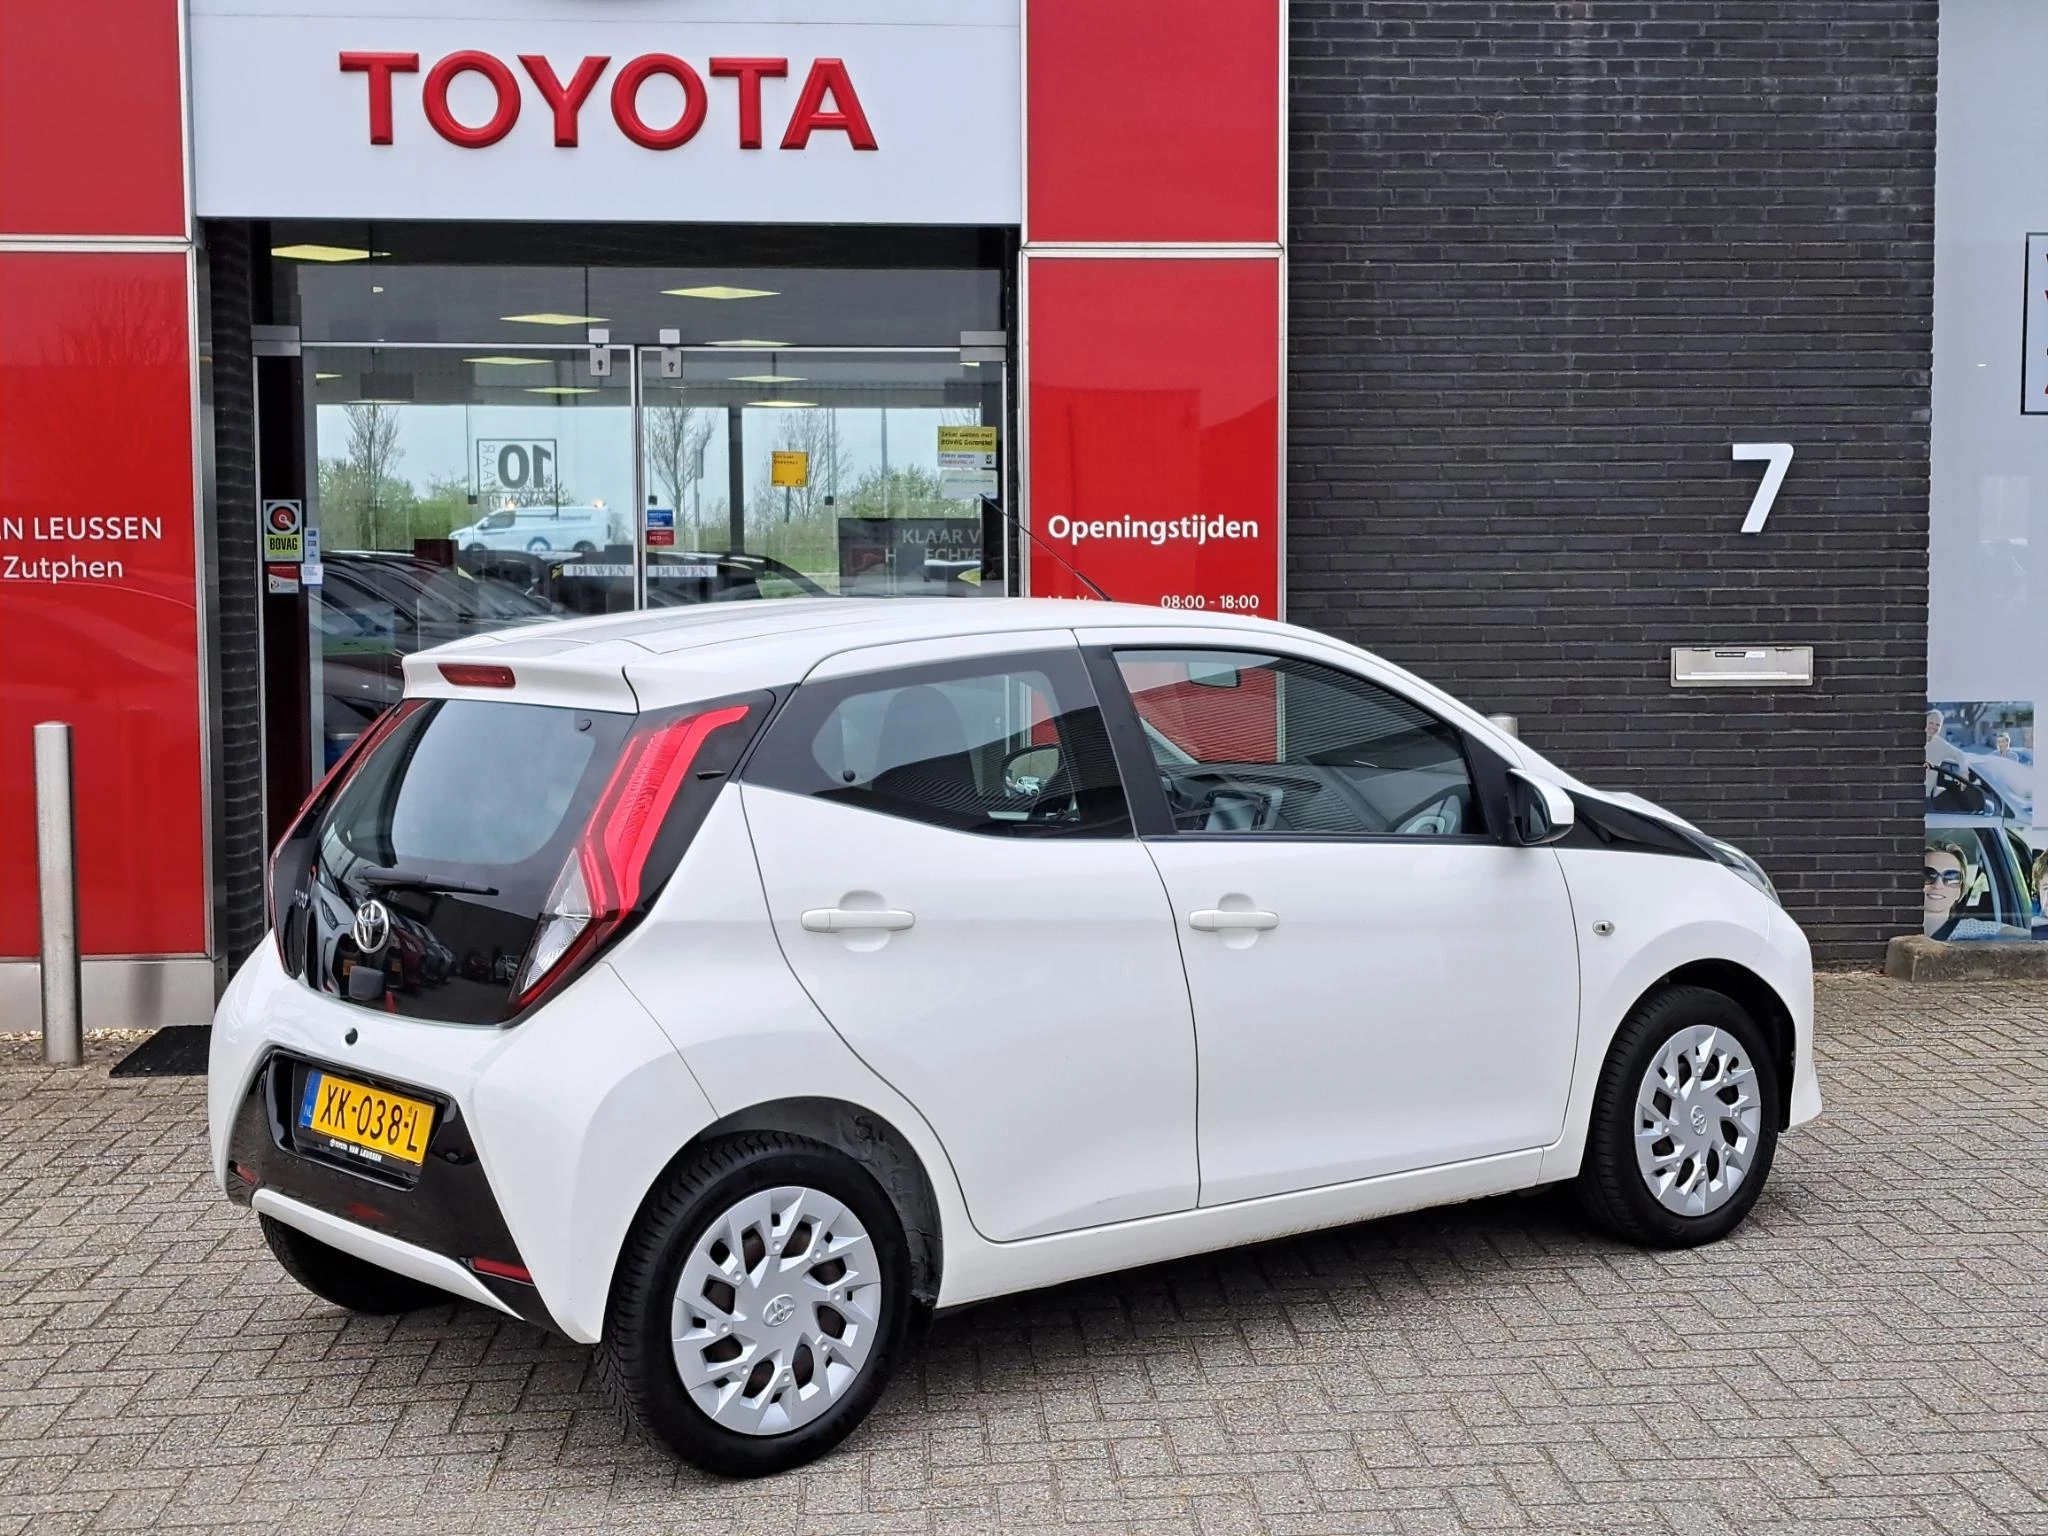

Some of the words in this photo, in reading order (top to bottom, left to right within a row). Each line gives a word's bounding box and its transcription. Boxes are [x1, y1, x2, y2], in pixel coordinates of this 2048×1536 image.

[339, 49, 879, 151] TOYOTA
[1732, 443, 1794, 533] 7
[0, 517, 23, 540] N
[34, 516, 162, 540] LEUSSEN
[902, 528, 963, 544] KLAAR
[1048, 514, 1259, 546] Openingstijden
[269, 538, 298, 551] BOVAG
[3, 554, 123, 584] Zutphen
[572, 565, 627, 576] DUWEN
[656, 566, 709, 577] DUWEN
[1161, 595, 1205, 609] 08:00
[1219, 595, 1260, 609] 18:00
[320, 1084, 419, 1153] XK-038-L
